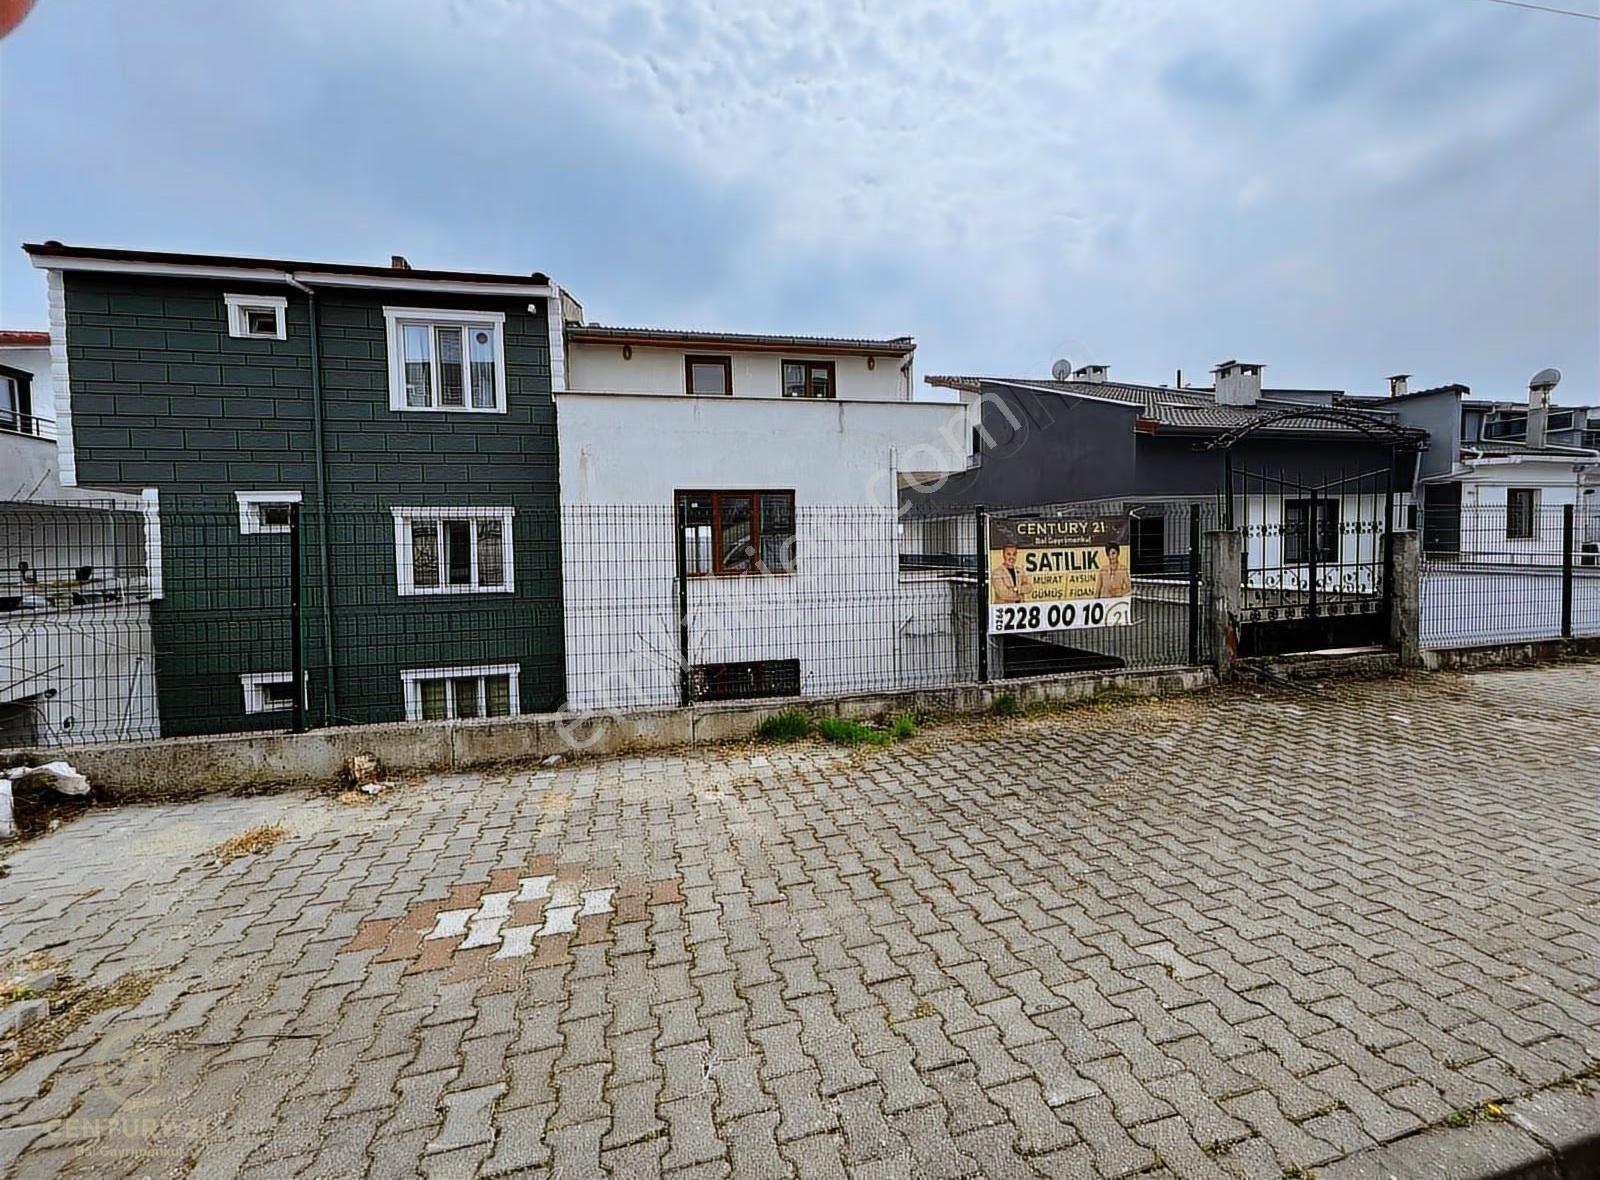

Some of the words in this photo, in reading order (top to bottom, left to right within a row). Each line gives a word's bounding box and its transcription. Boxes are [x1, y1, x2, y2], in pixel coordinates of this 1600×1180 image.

[1017, 522, 1088, 535] CENTURY
[1092, 521, 1105, 533] 21
[1026, 550, 1100, 572] SATILIK
[1033, 575, 1063, 585] MURAT
[1069, 574, 1096, 584] AYSUN
[1004, 606, 1041, 630] 228
[1047, 604, 1076, 627] 00
[1082, 602, 1104, 625] 10
